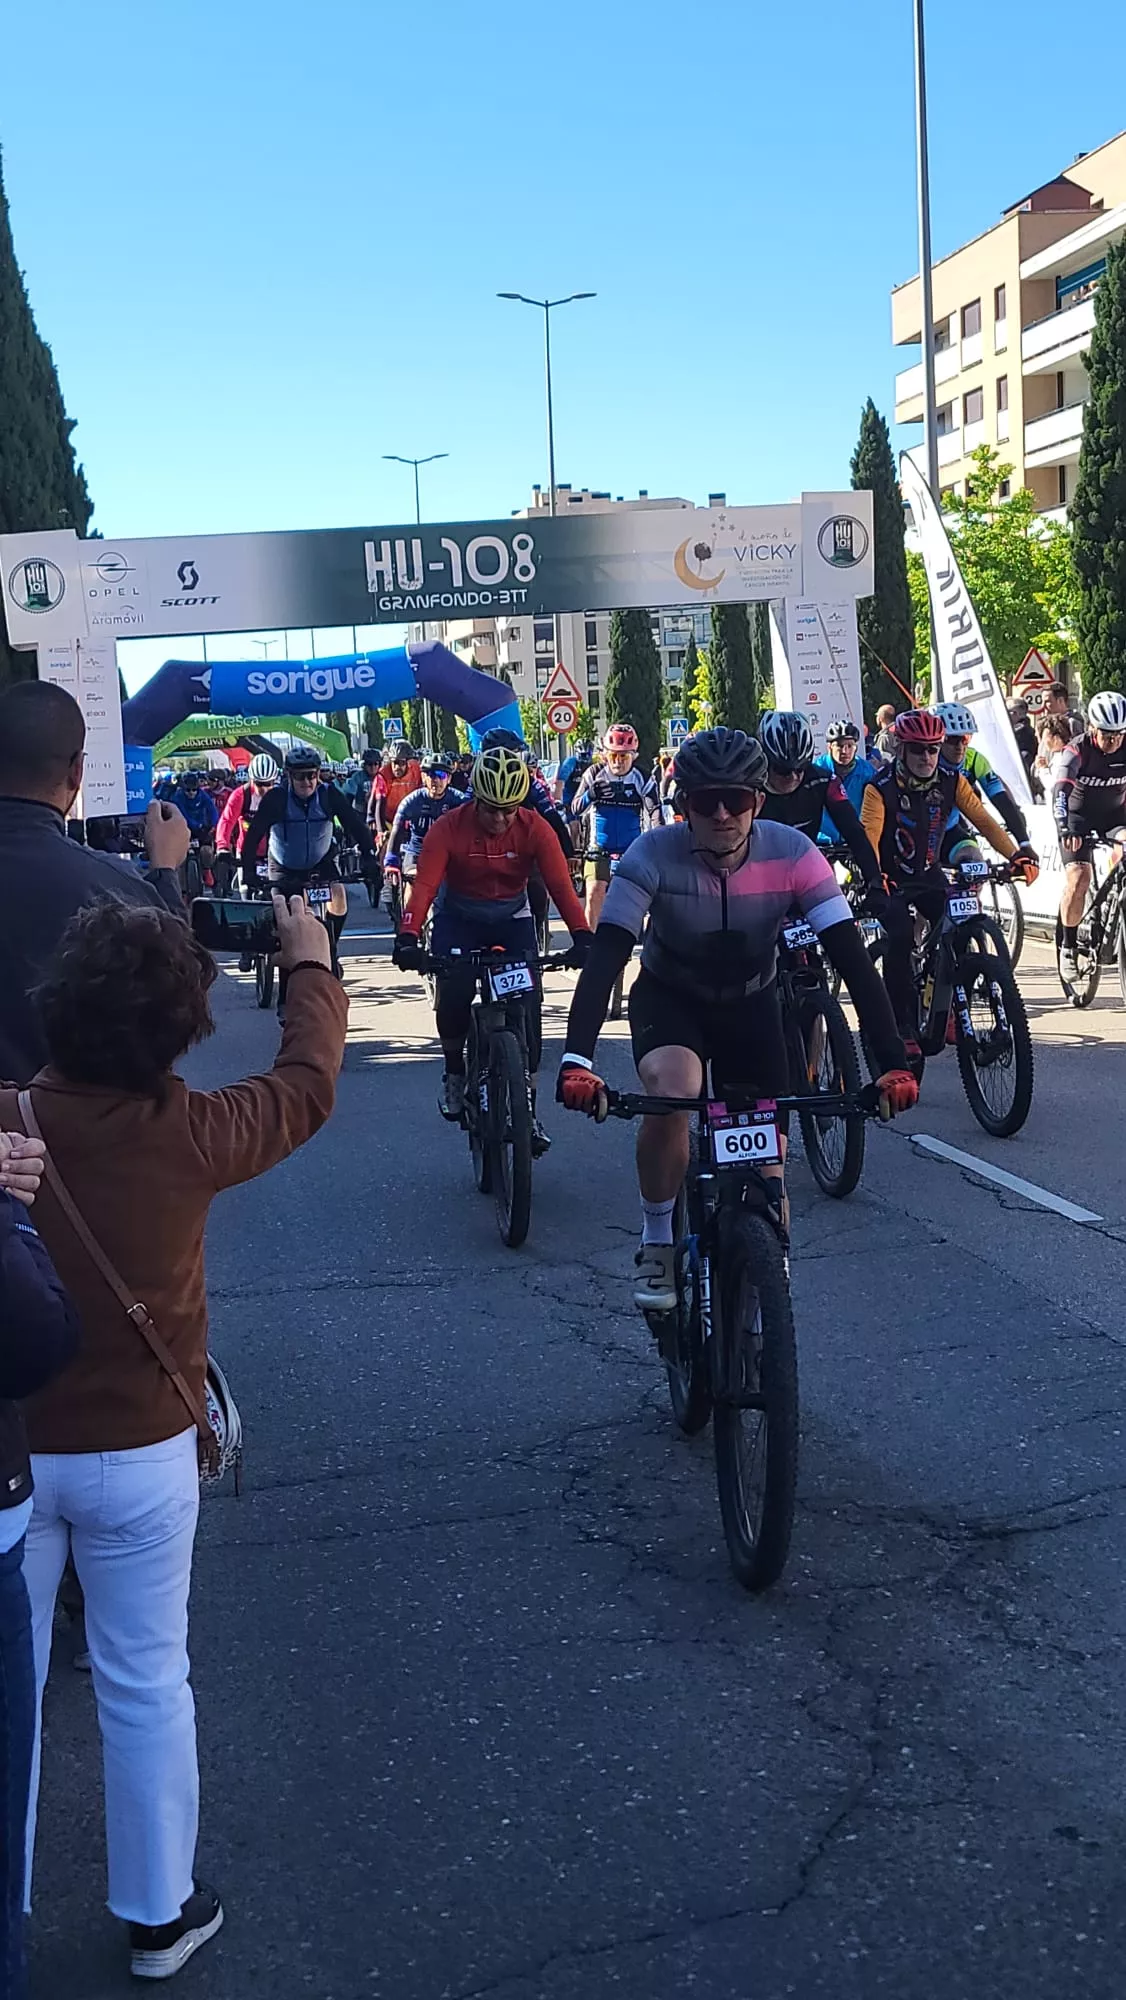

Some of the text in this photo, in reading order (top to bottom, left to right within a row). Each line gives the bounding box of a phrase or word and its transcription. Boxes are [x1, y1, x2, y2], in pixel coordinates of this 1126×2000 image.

[364, 533, 536, 593] HU-108
[89, 587, 140, 598] OPEL
[160, 596, 221, 608] SCOTT
[1025, 694, 1043, 705] 20
[554, 712, 572, 723] 20
[966, 863, 984, 873] 307
[952, 900, 977, 913] 1053
[499, 973, 526, 989] 372
[725, 1131, 767, 1154] 600
